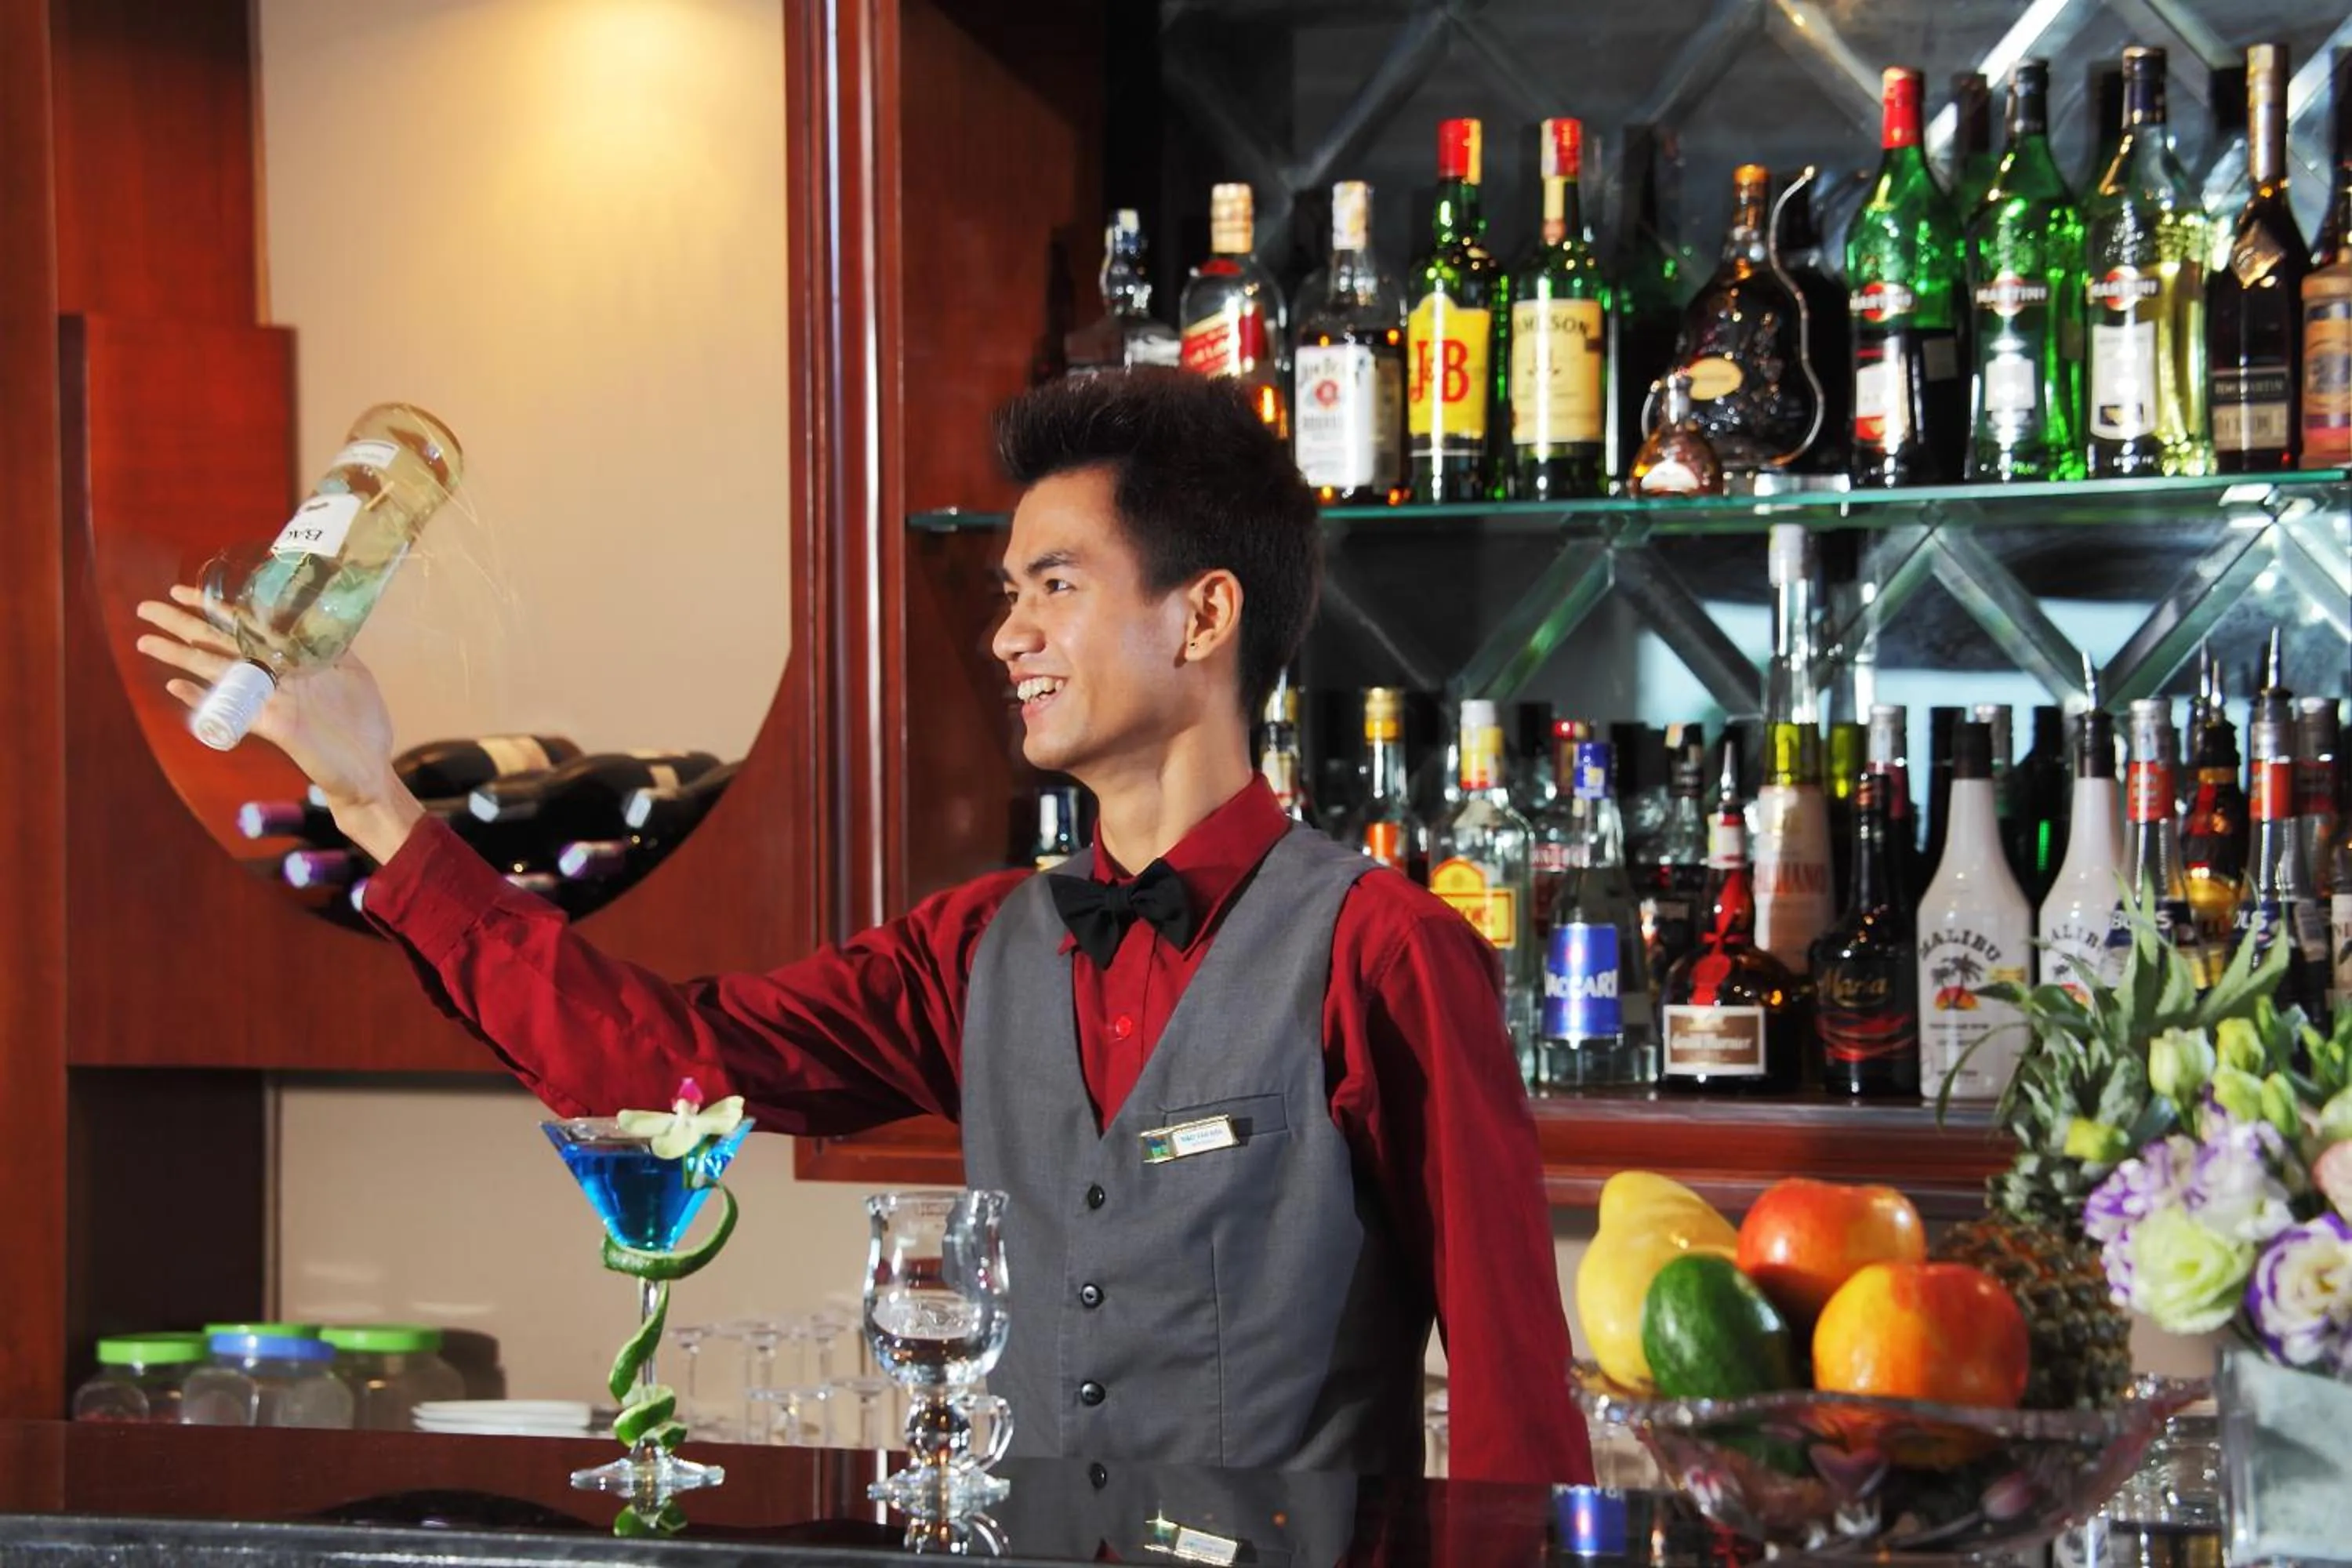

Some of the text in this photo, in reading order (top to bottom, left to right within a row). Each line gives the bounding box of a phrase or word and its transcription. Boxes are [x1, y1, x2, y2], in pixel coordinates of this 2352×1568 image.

[1976, 285, 2047, 303] MARTINI
[2109, 910, 2174, 931] BOS
[1918, 929, 2003, 963] MALIBU
